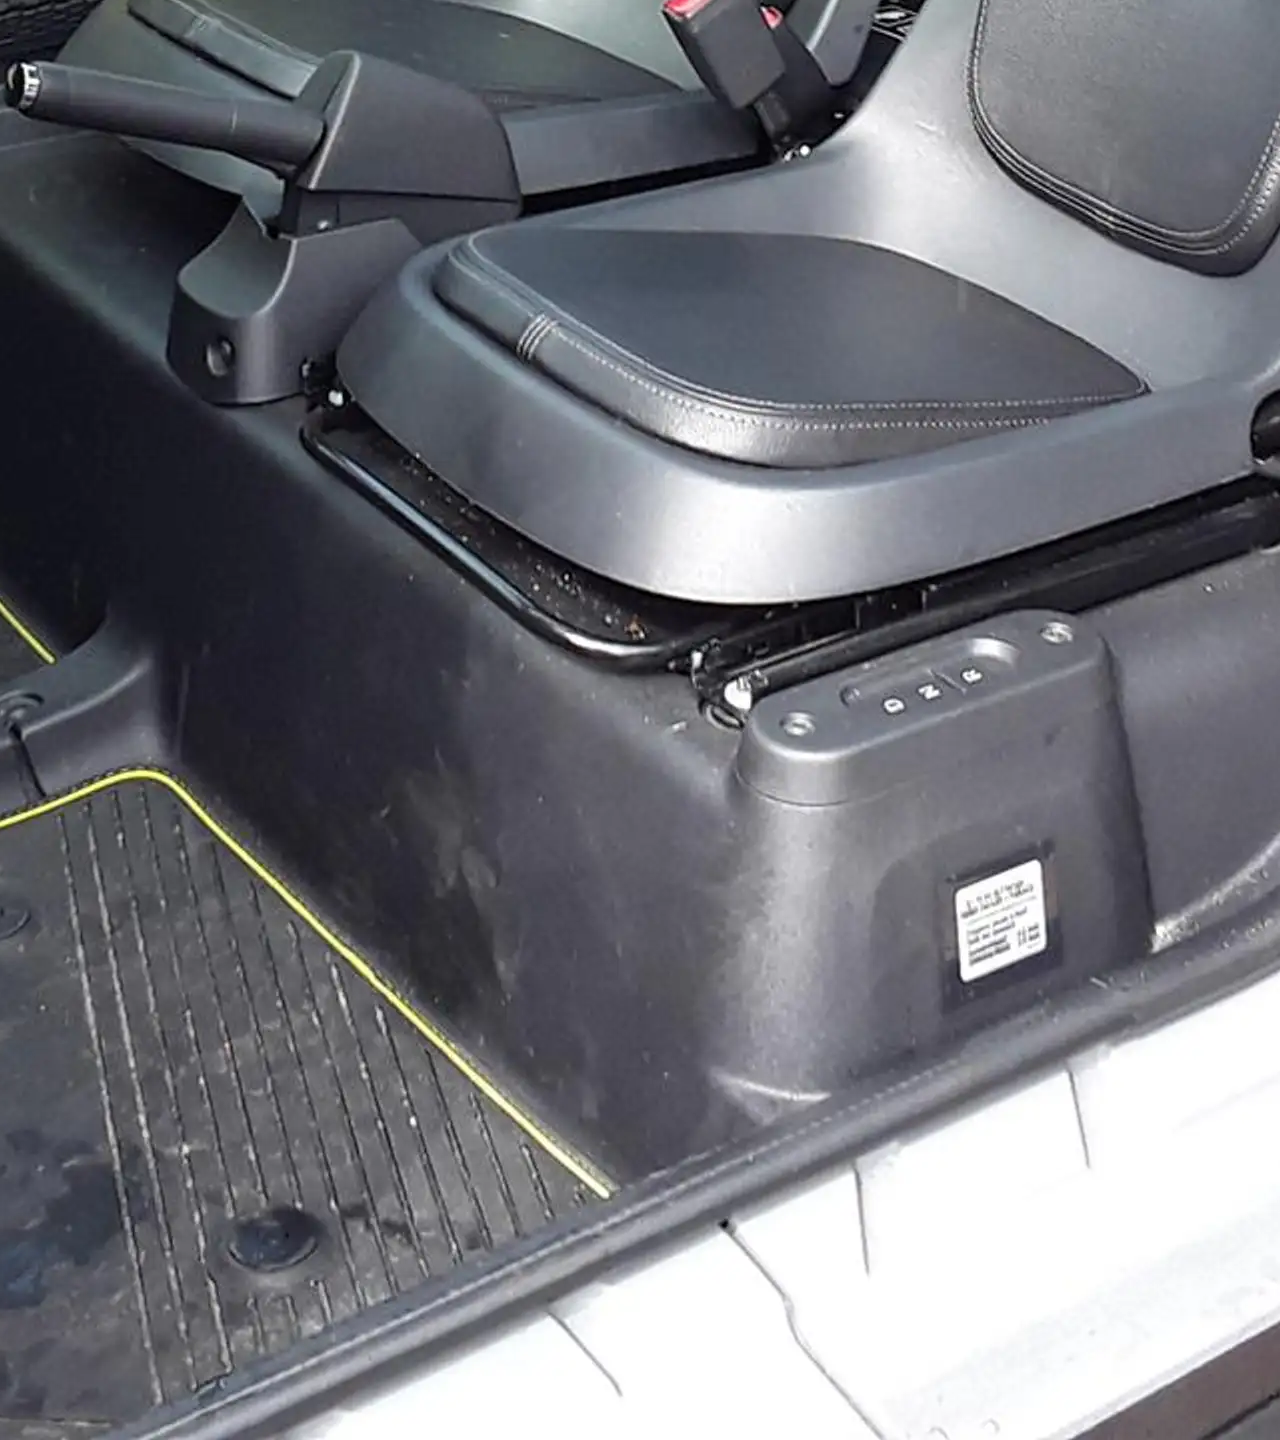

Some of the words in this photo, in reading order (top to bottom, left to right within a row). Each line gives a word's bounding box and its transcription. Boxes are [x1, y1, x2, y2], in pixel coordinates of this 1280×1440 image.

[883, 698, 905, 714] D
[918, 683, 942, 700] N
[961, 668, 984, 685] R
